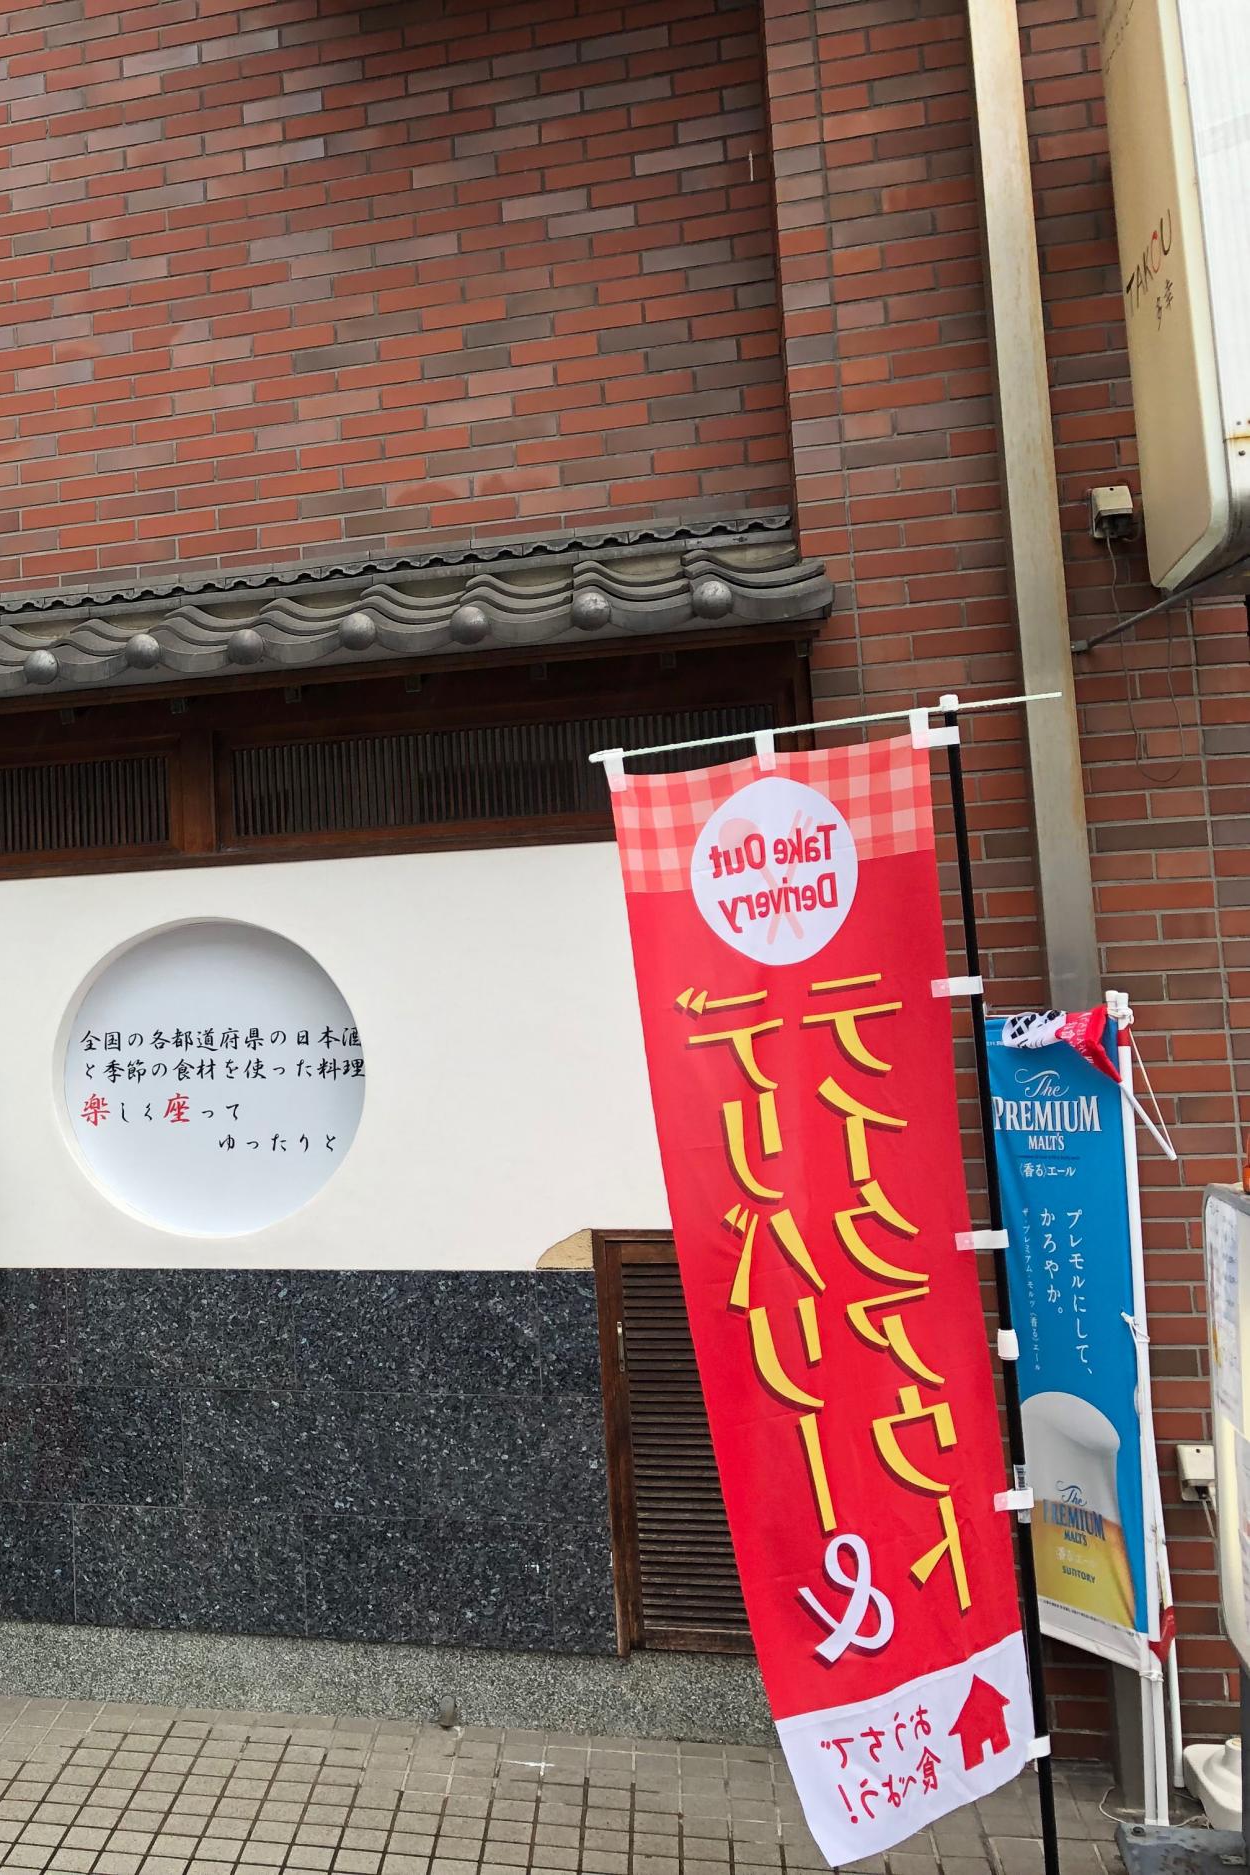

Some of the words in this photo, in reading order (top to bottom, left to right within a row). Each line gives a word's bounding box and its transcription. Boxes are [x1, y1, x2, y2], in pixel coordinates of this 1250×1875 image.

[80, 1026, 361, 1052] 全国の各都道府県の日本酒
[84, 1058, 366, 1084] と季節の食材を使った料理
[1015, 1068, 1069, 1098] The
[80, 1093, 240, 1126] 楽しく座って
[993, 1095, 1102, 1133] PREMIUM
[218, 1134, 337, 1152] ゆったりと
[1028, 1132, 1065, 1151] MALT'S
[1062, 1566, 1096, 1584] SUNTORY
